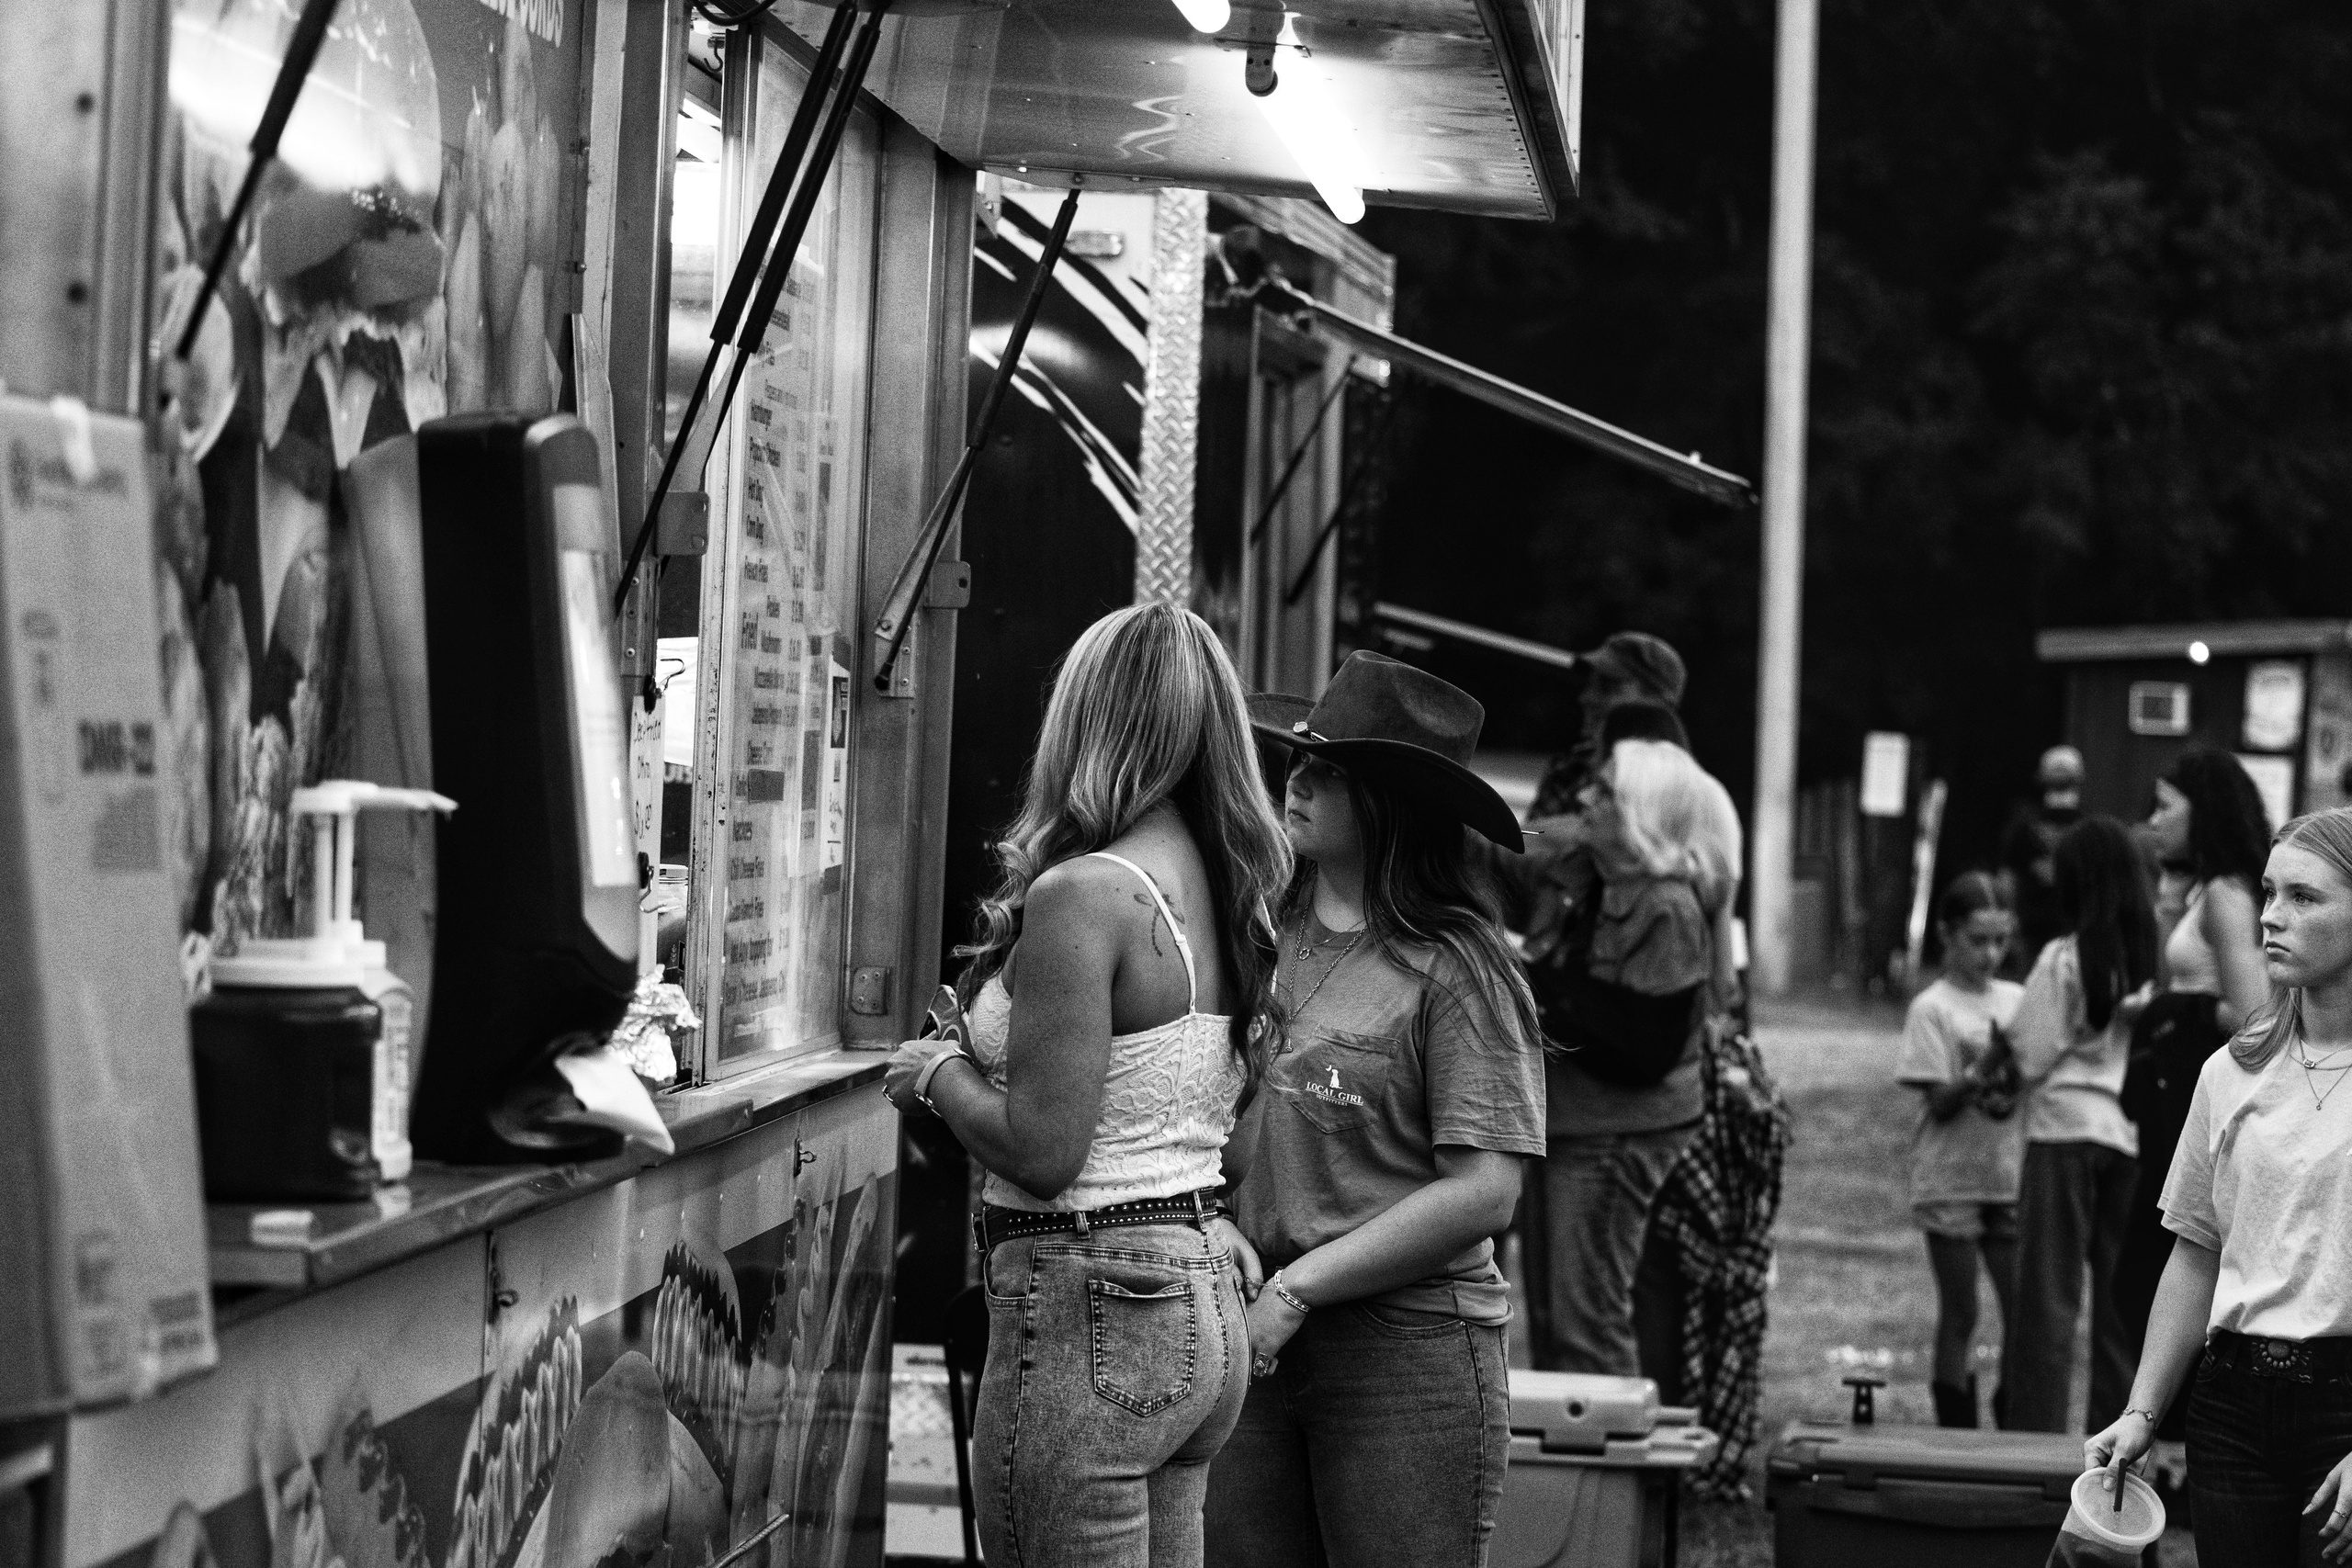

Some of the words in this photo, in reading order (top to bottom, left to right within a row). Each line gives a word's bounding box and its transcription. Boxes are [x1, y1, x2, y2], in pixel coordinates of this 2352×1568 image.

[1306, 1081, 1336, 1099] LOCAL
[1338, 1091, 1364, 1105] GIRL
[1316, 1094, 1348, 1107] OUTFITTERS
